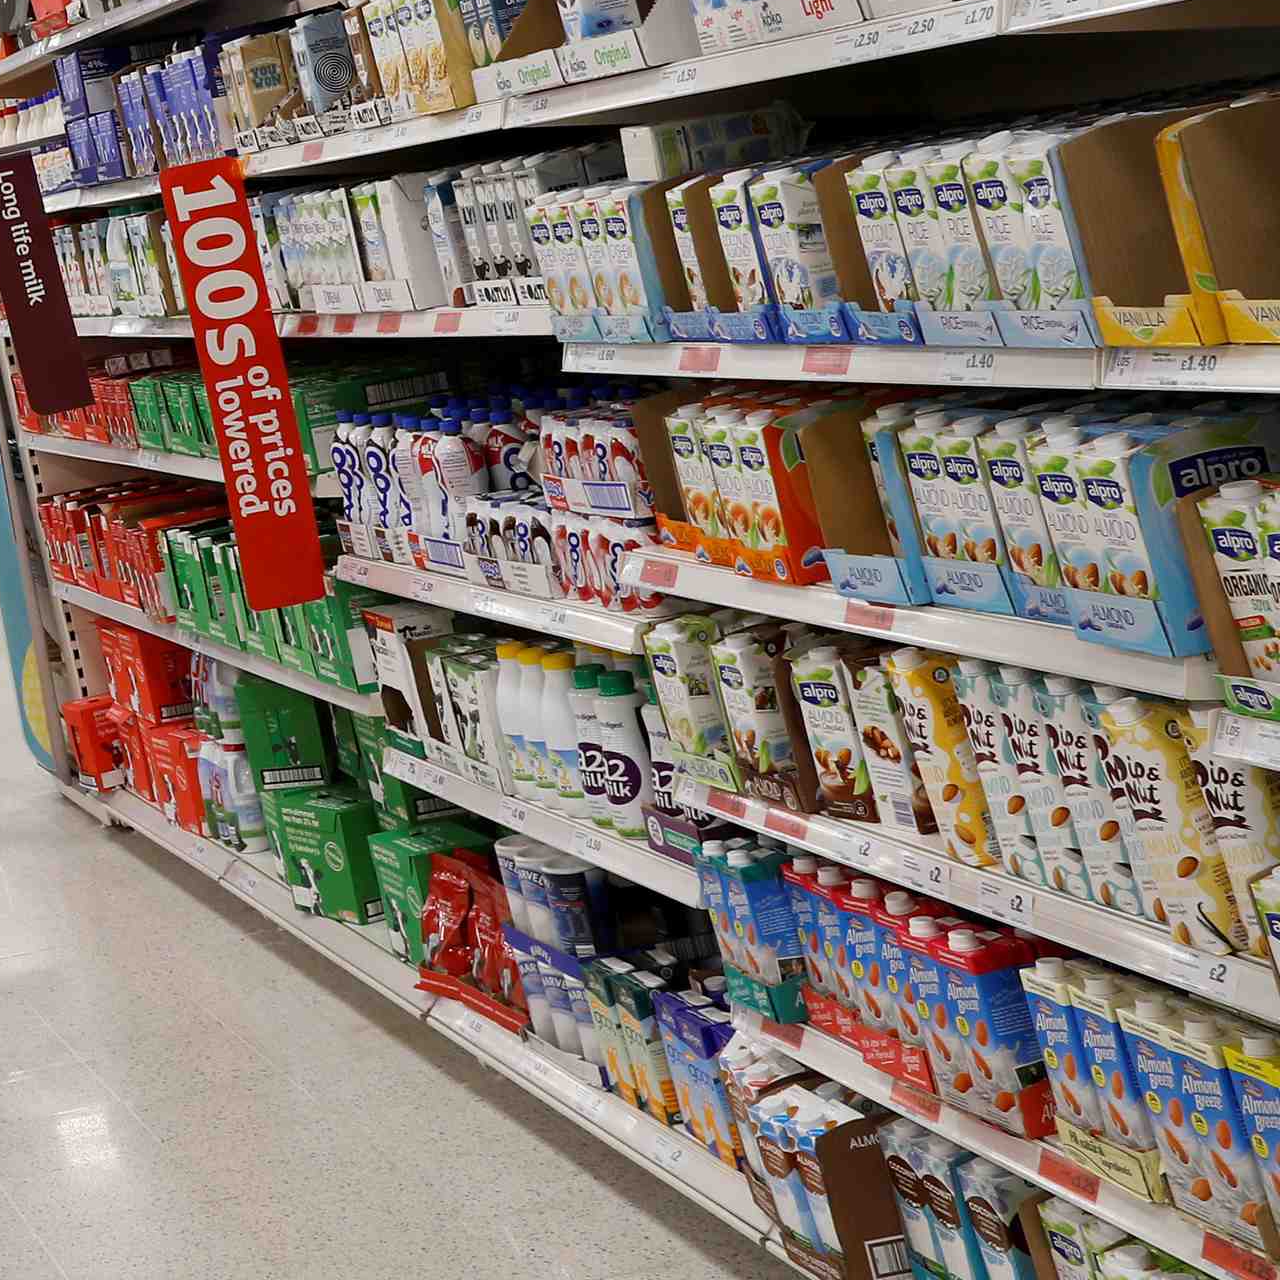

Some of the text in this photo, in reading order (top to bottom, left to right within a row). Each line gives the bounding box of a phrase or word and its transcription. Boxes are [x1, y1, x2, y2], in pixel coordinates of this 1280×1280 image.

[964, 5, 994, 25] £1.70
[907, 19, 936, 36] £2.50
[854, 31, 880, 49] £2.50
[593, 43, 633, 68] Original
[517, 62, 552, 86] Original
[859, 193, 886, 211] alpro
[896, 191, 922, 209] alpro
[938, 187, 965, 204] alpro
[975, 184, 1005, 202] alpro
[10, 221, 32, 257] life
[19, 254, 48, 308] milk
[171, 174, 259, 368] 100s
[1112, 311, 1167, 328] VANILLA
[966, 354, 994, 370] £1.40
[1180, 354, 1217, 372] £1.40
[214, 375, 270, 518] lowered
[247, 367, 297, 518] of prices
[909, 454, 939, 475] alpro
[945, 457, 975, 477] alpro
[991, 462, 1021, 483] alpro
[1178, 453, 1262, 489] alpro
[1042, 477, 1073, 497] alpro
[1087, 482, 1120, 502] alpro
[1215, 532, 1254, 554] alpro
[1223, 573, 1271, 597] ORGANIC
[1090, 605, 1136, 627] ALMOND
[802, 681, 838, 703] alpro
[1125, 783, 1163, 806] Nut
[1206, 788, 1246, 814] Nut
[1010, 895, 1024, 913] £2
[1209, 963, 1227, 982] £2
[1137, 1052, 1175, 1077] Almond
[1148, 1070, 1176, 1090] Breeze
[1182, 1071, 1222, 1098] Almond
[1195, 1091, 1225, 1113] Breeze
